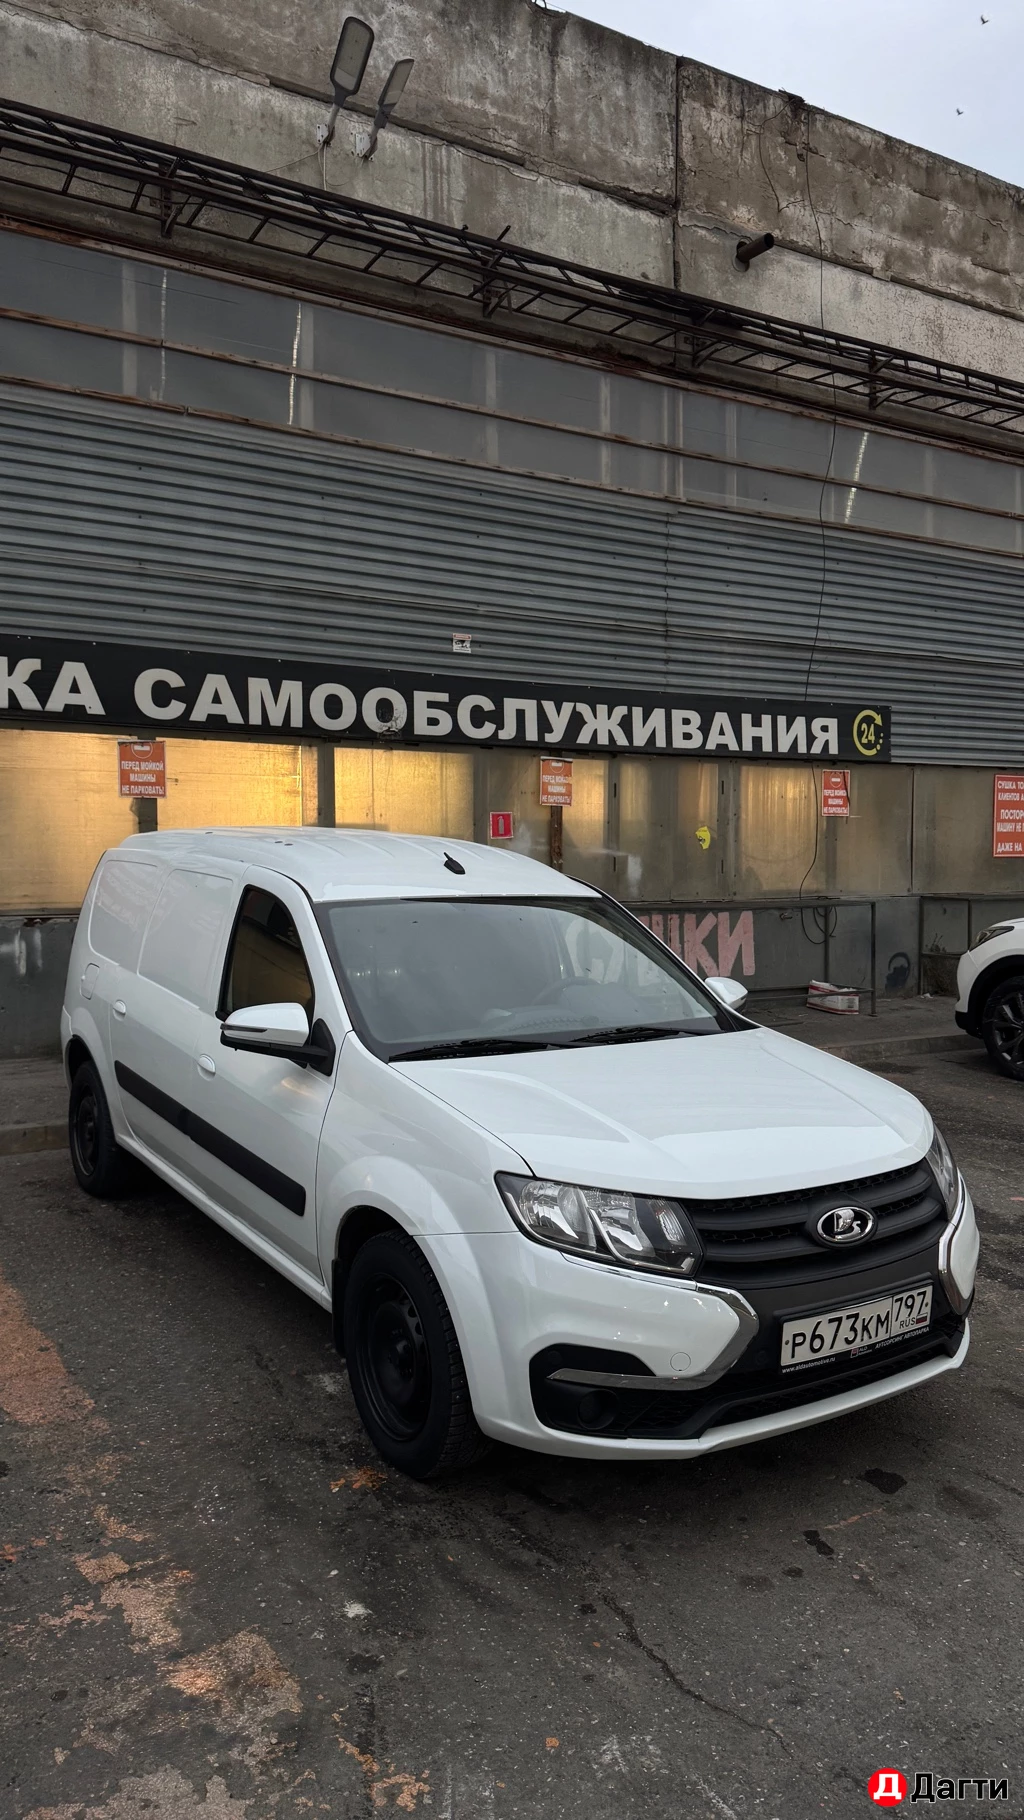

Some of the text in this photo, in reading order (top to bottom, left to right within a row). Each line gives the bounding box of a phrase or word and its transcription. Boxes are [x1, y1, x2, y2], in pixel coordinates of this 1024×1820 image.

[134, 667, 839, 755] САМООБСЛУЖИВАНИЯ
[861, 722, 875, 744] 24
[121, 760, 164, 771] ПЕРЕД МОЙКОЙ
[130, 773, 156, 782] МАШИНЫ
[122, 785, 129, 793] НЕ
[997, 780, 1016, 790] СУШКА
[997, 792, 1020, 801] КЛИЕНТОВ
[1000, 809, 1024, 820] ПОСТОР
[996, 822, 1015, 833] МАШИНУ
[1015, 822, 1022, 833] НЕ
[996, 842, 1022, 853] ДАЖЕ НА
[790, 1290, 927, 1358] Р673КМ 797
[899, 1316, 916, 1330] RUS
[782, 1357, 836, 1373] www.aldautomotive.ru
